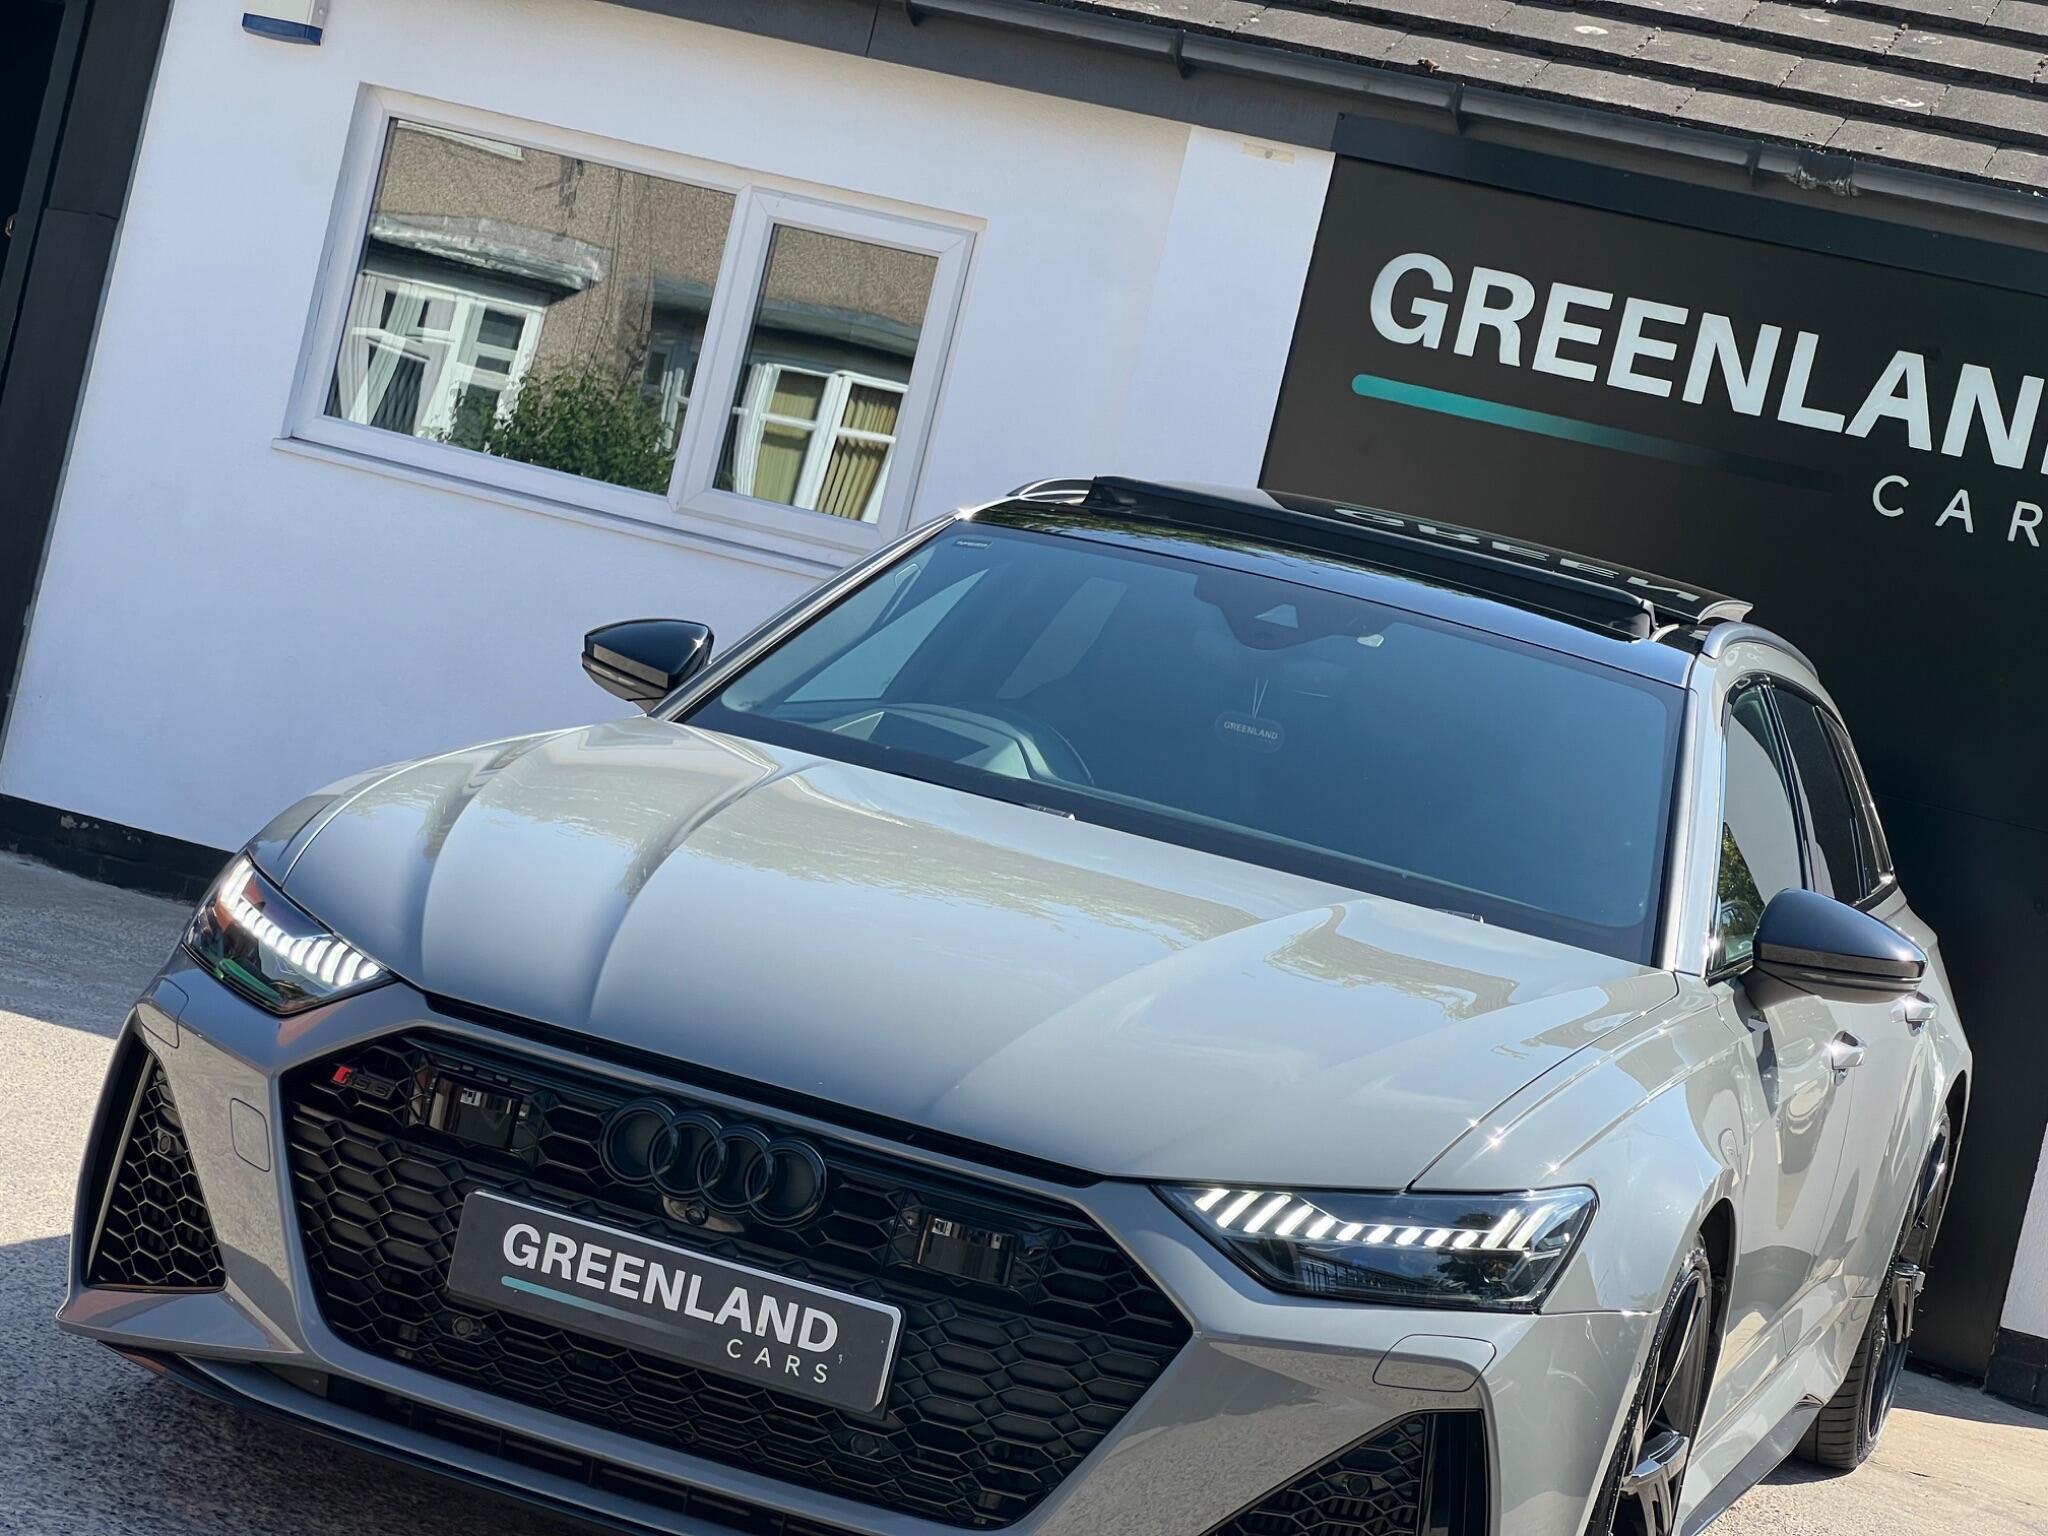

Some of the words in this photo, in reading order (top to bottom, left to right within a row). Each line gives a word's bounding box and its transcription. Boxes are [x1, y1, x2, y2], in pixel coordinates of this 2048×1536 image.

[1370, 253, 2048, 475] GREENLAN
[1223, 721, 1278, 740] GREENLAND
[503, 1223, 838, 1353] GREENLAND
[727, 1338, 828, 1383] CARS
